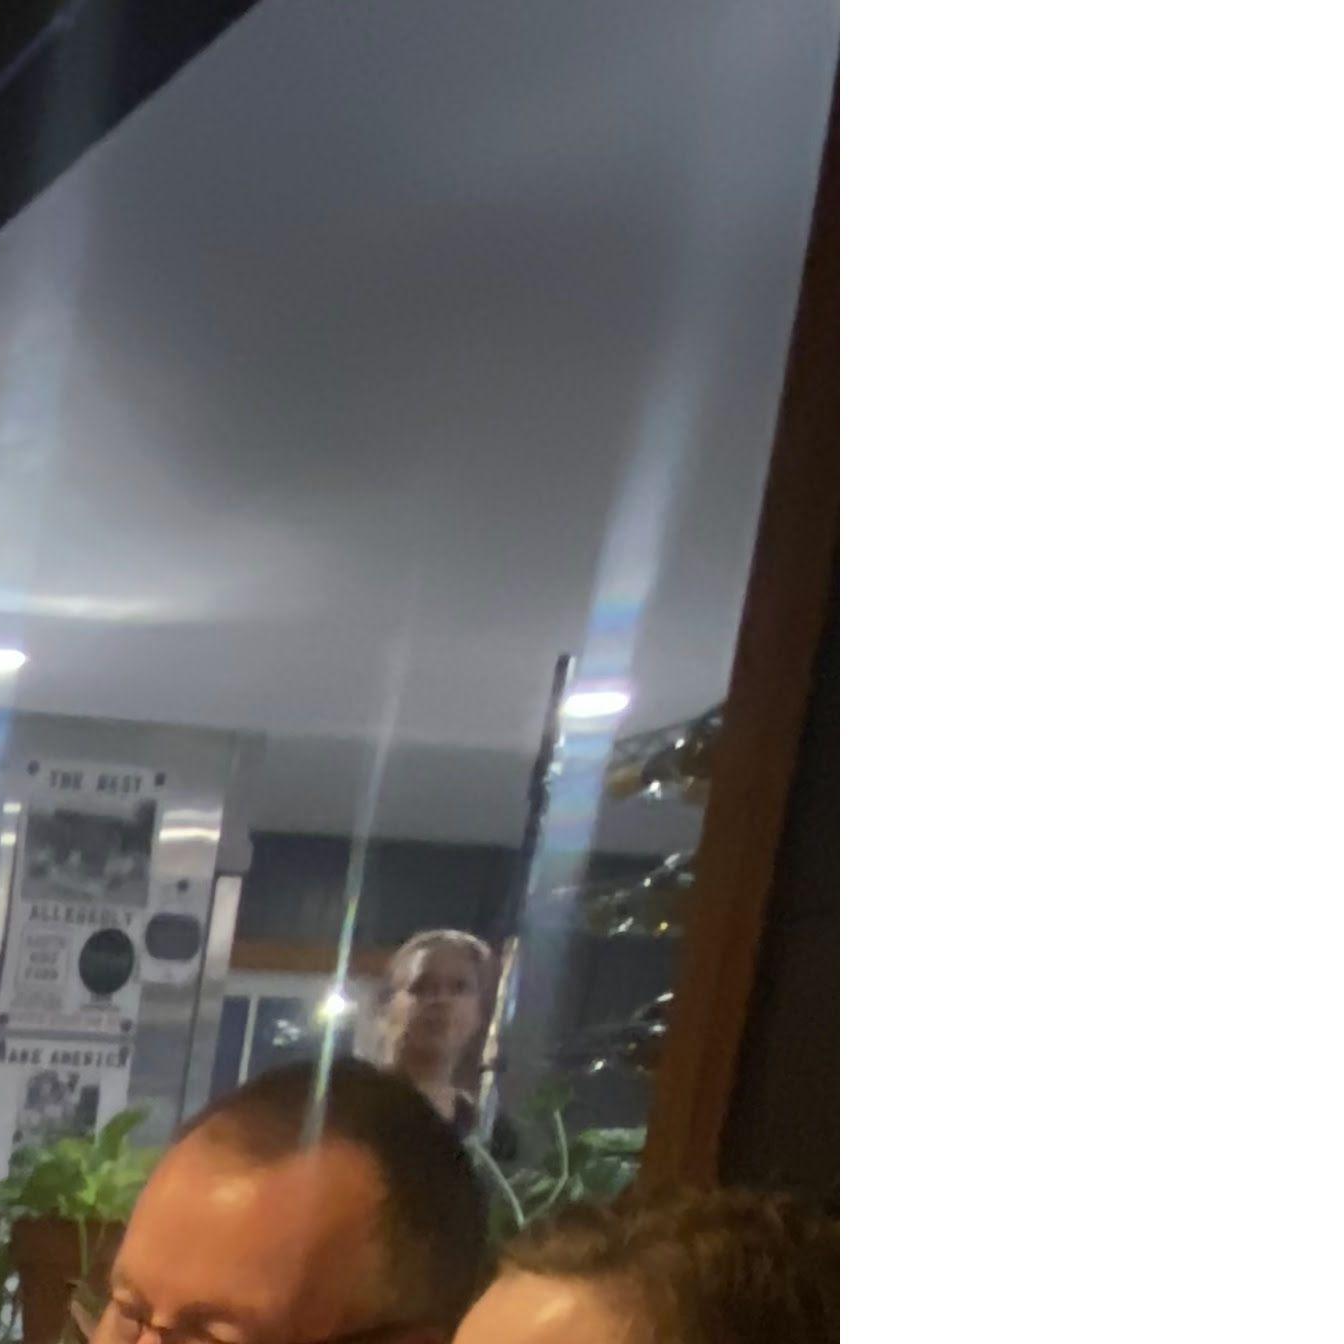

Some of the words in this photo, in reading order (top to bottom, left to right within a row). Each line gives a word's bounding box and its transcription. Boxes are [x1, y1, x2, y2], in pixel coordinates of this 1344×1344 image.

[50, 770, 83, 790] THE
[97, 773, 141, 792] BEST
[50, 1047, 128, 1068] AMERICA
